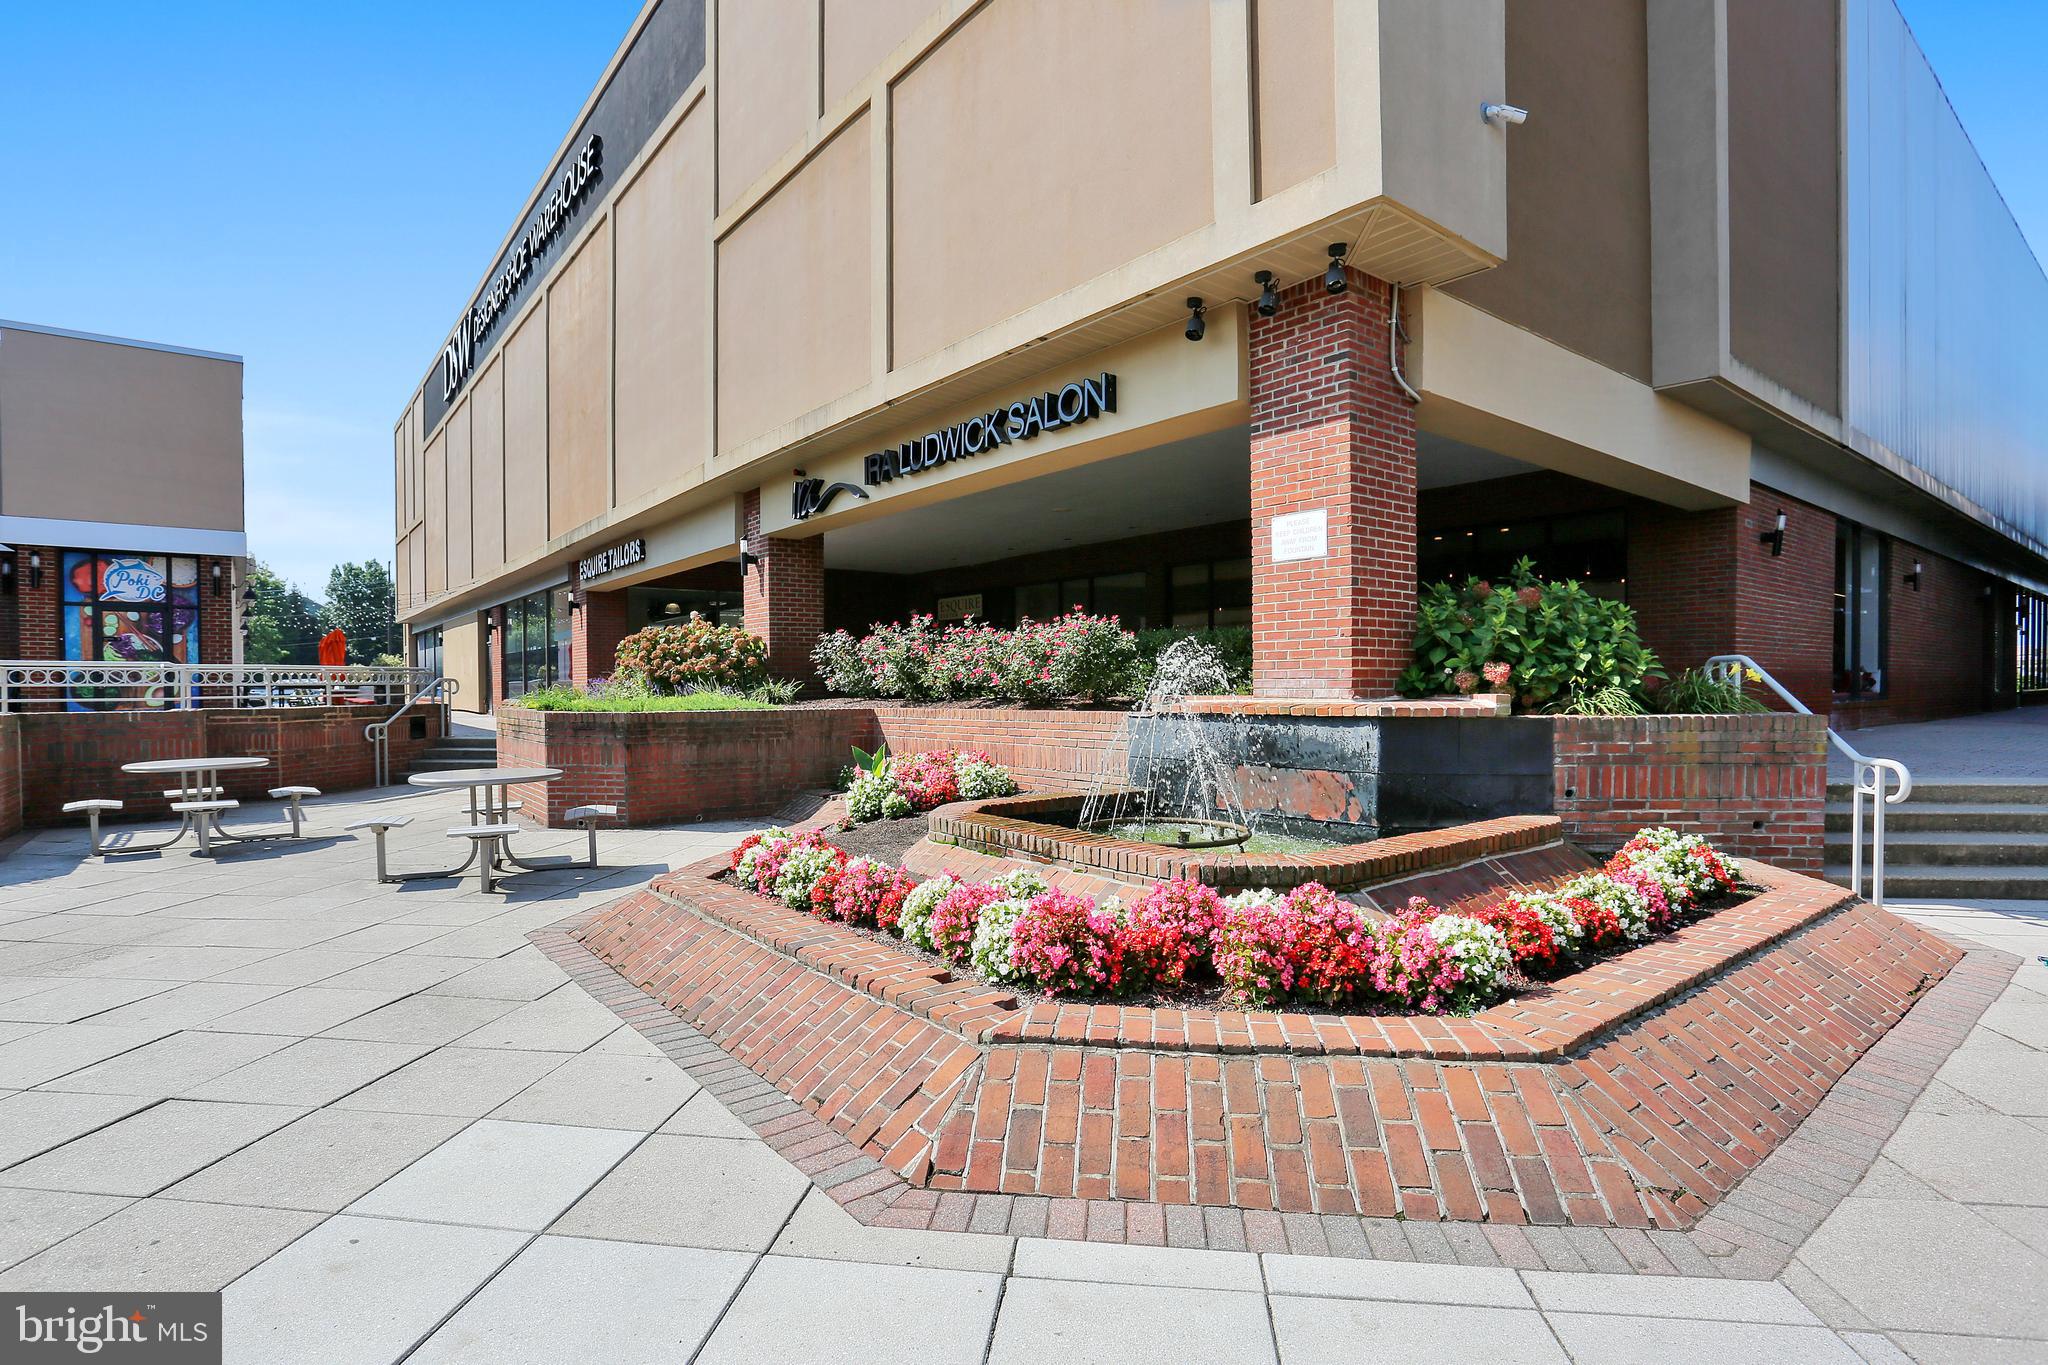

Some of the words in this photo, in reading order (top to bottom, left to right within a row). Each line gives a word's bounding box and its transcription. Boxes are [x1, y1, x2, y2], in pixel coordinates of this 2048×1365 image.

[443, 307, 472, 402] DSW
[473, 275, 504, 343] DESIGNER
[504, 237, 527, 294] SHOE
[528, 134, 598, 257] WAREHOUSE
[899, 408, 1003, 475] LUDWICK
[1007, 371, 1115, 441] SALON
[580, 552, 608, 580] ESQUIRE
[608, 539, 642, 572] TAILORS
[113, 571, 150, 589] Poki
[136, 586, 166, 600] DC
[939, 596, 981, 612] ESQUIRE
